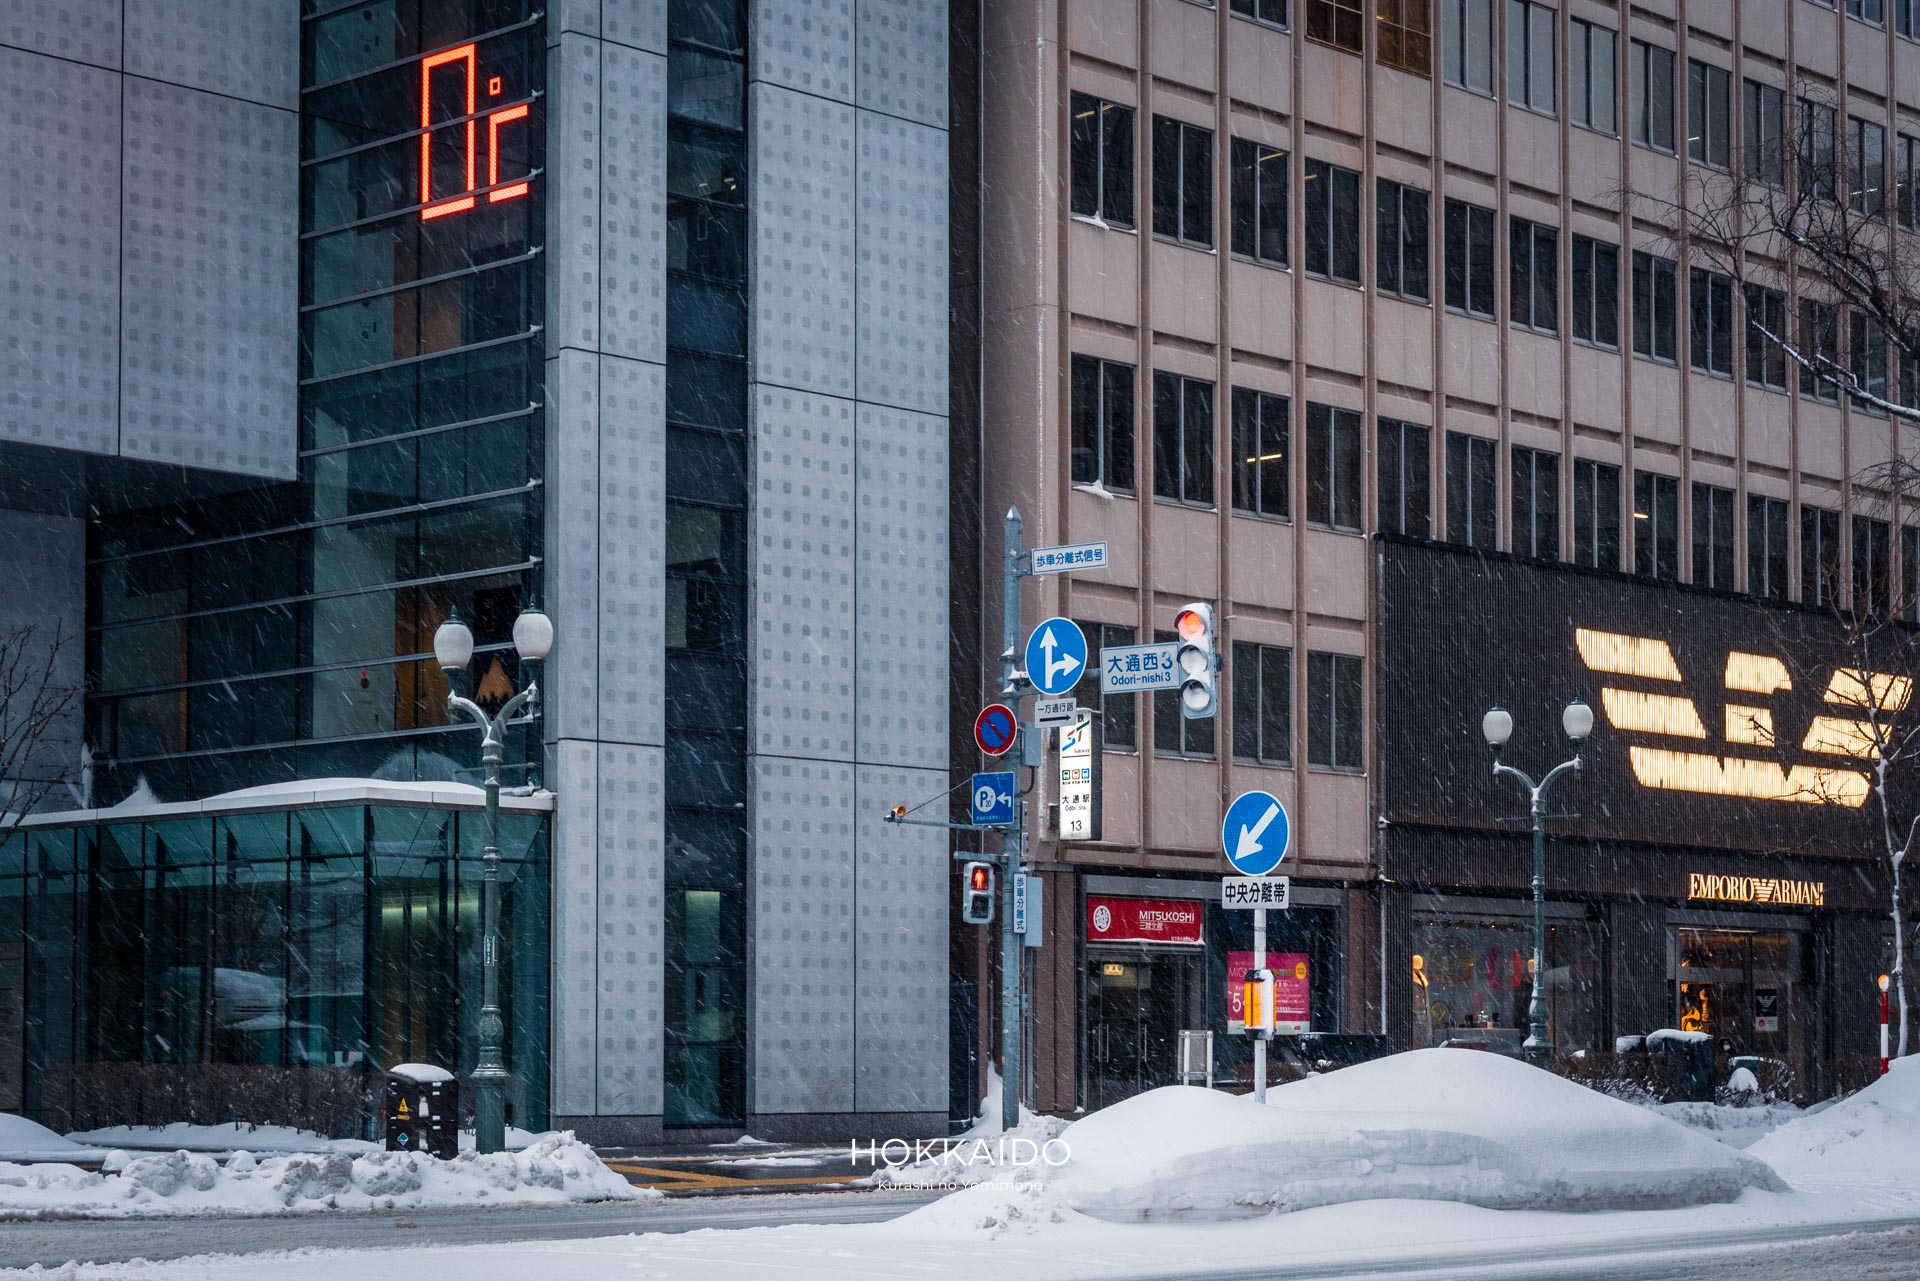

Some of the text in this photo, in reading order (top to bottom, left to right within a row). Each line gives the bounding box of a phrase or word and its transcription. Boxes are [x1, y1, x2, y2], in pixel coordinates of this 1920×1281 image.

[1036, 548, 1103, 567] 歩車分離式信号
[1107, 651, 1173, 674] 大通西3
[1037, 702, 1074, 714] 一方通行路
[1062, 794, 1090, 804] 大通駅
[1070, 820, 1082, 831] 13
[1225, 882, 1286, 904] 中央分離帯
[1689, 873, 1824, 906] EMPORIO ARMANI
[1016, 877, 1024, 930] 歩車分離式
[1139, 910, 1195, 922] MITSUKOSHI
